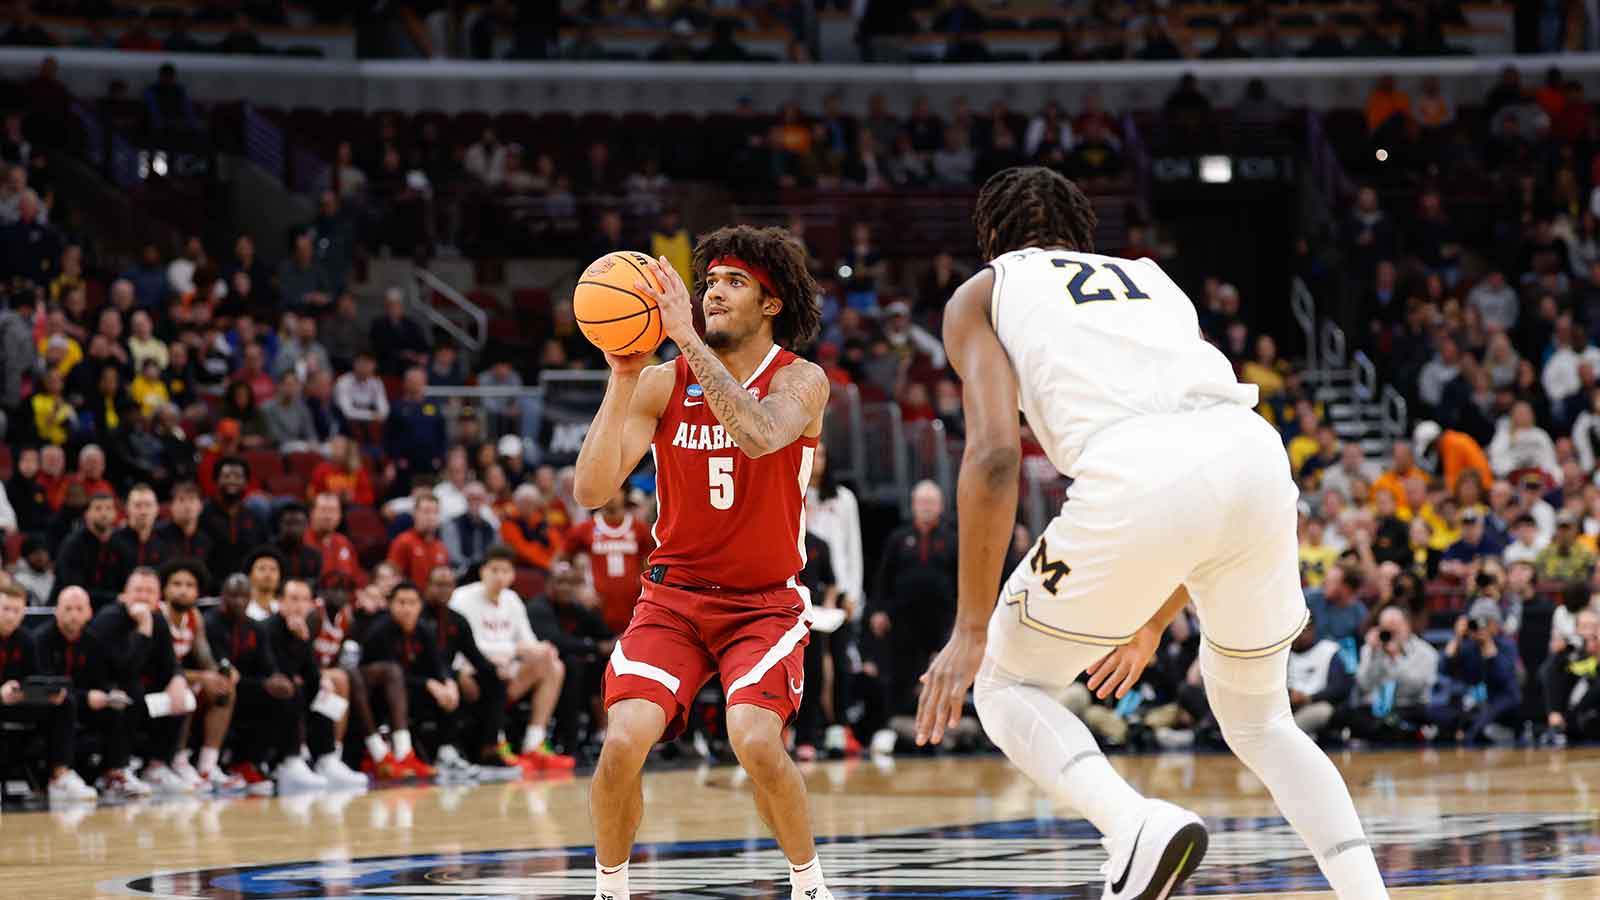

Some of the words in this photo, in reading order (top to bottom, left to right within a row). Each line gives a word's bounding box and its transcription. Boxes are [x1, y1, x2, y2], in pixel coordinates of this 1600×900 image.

[1051, 258, 1151, 304] 21
[672, 421, 739, 450] ALABA
[708, 456, 735, 510] 5
[1030, 536, 1071, 596] M
